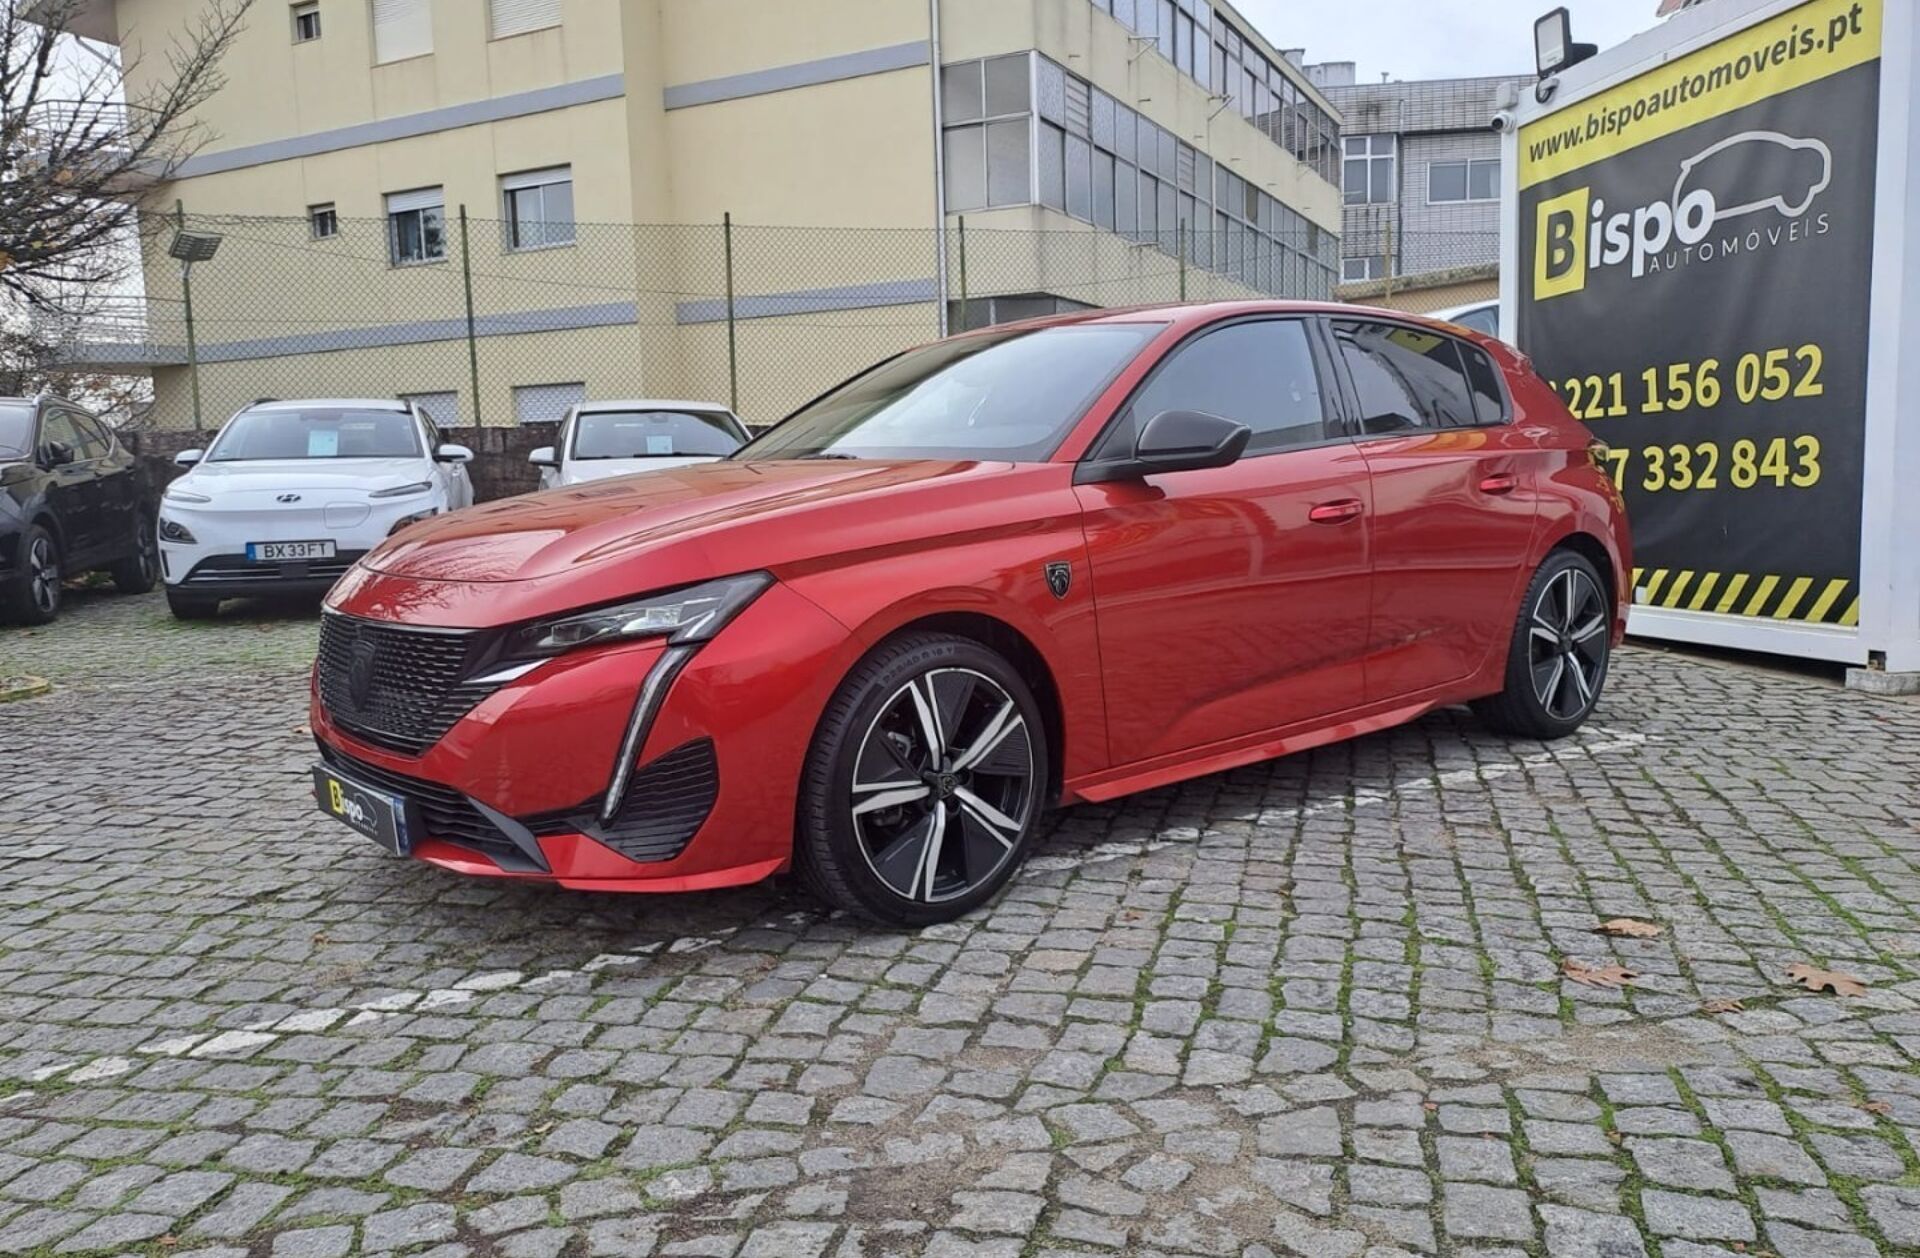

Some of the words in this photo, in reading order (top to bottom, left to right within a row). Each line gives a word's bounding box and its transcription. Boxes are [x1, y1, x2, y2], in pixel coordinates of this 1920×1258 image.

[1529, 3, 1862, 163] www.bispoautomoveis.pt
[1544, 188, 1716, 281] Bispo
[1648, 212, 1830, 274] AUTOMÓVEIS
[1565, 372, 1627, 419] 221
[1641, 358, 1720, 414] 156
[1735, 343, 1824, 403] 052
[1641, 441, 1718, 492] 332
[1730, 435, 1821, 489] 843
